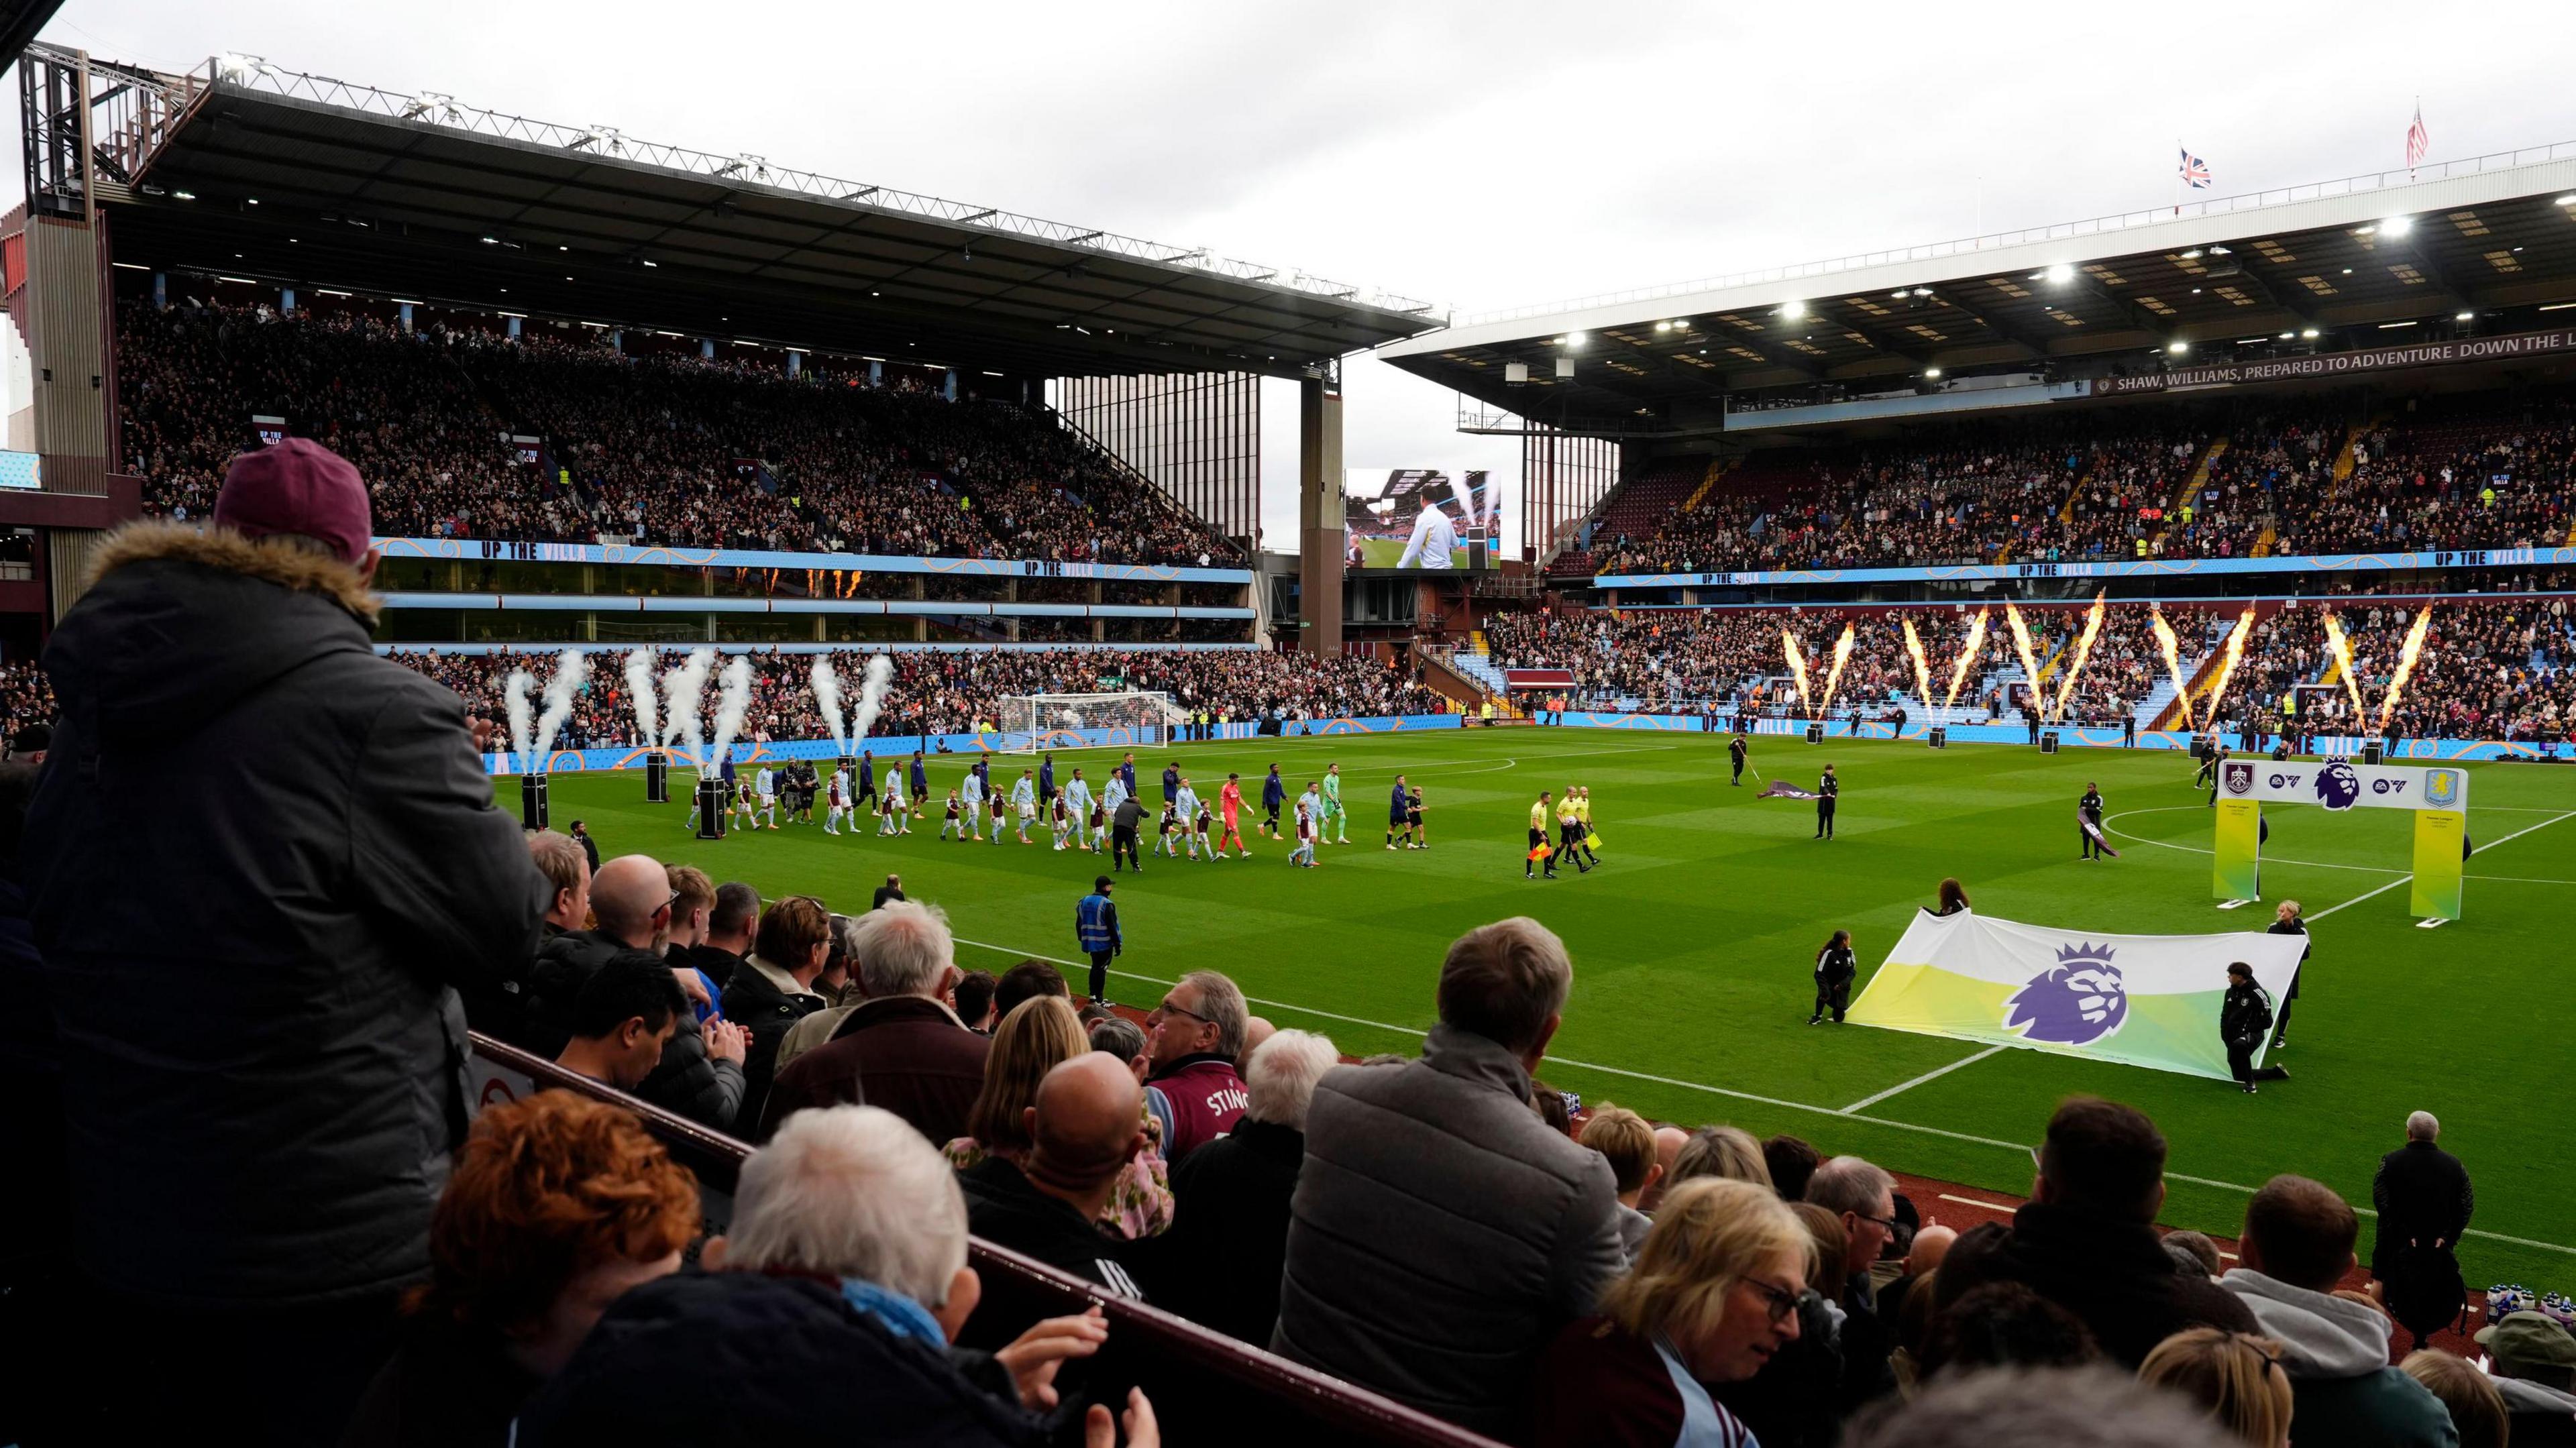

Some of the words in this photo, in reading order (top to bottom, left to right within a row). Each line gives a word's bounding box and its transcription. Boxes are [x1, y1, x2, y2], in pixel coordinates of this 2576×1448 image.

[2118, 376, 2163, 390] SHAW,
[2166, 368, 2241, 386] WILLIAMS,
[2245, 359, 2322, 379] PREPARED
[2326, 357, 2348, 370] TO
[2351, 345, 2453, 368] ADVENTURE
[2459, 338, 2520, 357] DOWN
[2524, 334, 2560, 349] THE
[482, 541, 501, 559] UP
[509, 542, 537, 559] THE
[543, 543, 587, 561] VILLA
[2436, 552, 2453, 565] UP
[2460, 551, 2485, 565] THE
[2493, 549, 2534, 565] VILLA
[1025, 561, 1038, 575] UP
[1043, 562, 1061, 575] THE
[1065, 563, 1093, 577] VILLA
[2020, 565, 2033, 576] UP
[2038, 564, 2057, 576] THE
[2061, 563, 2092, 576] VILLA
[1703, 573, 1713, 583] UP
[1717, 573, 1731, 583] THE
[1184, 724, 1214, 740] THE
[1703, 714, 1718, 732] UP
[1756, 718, 1793, 735] VILLA
